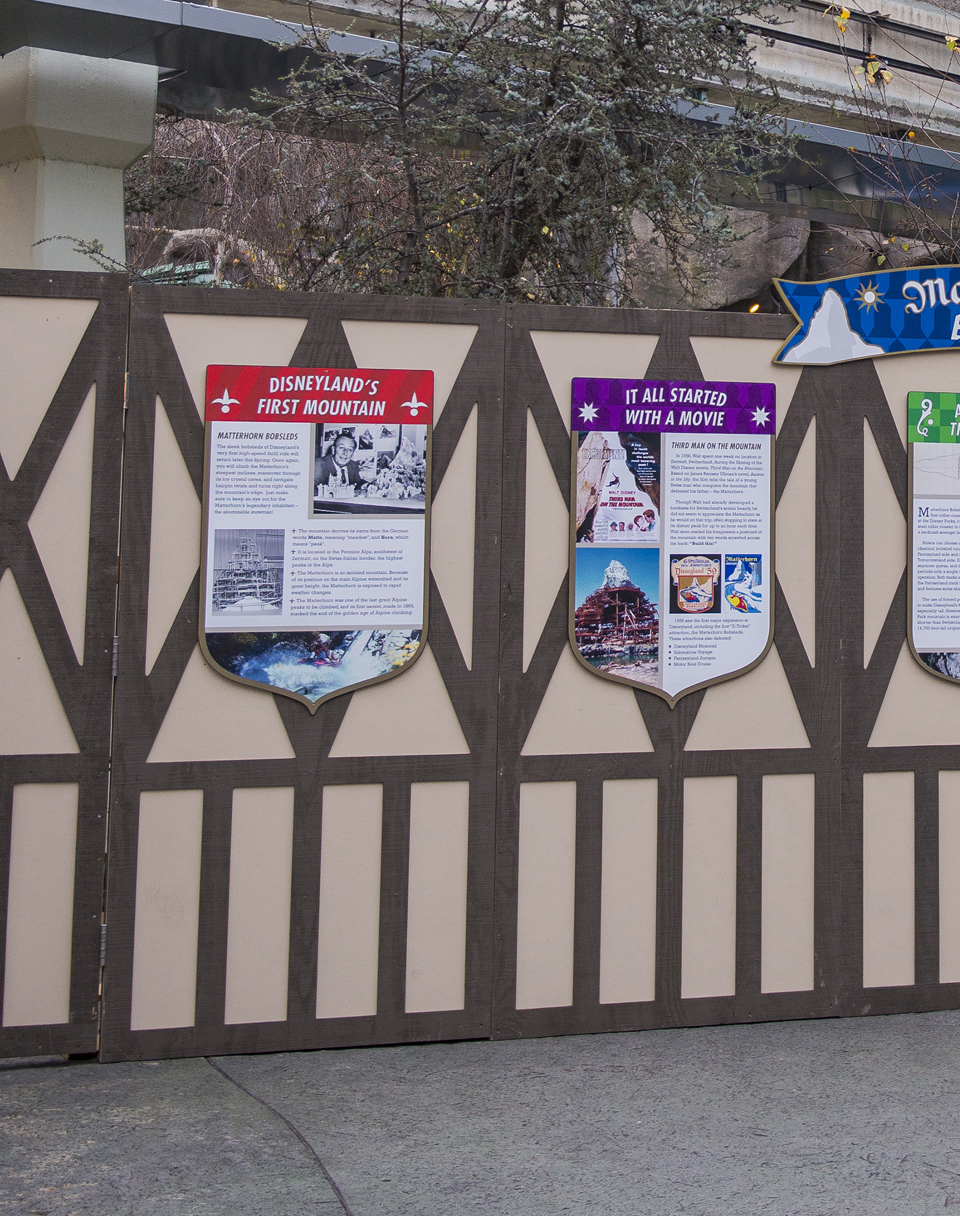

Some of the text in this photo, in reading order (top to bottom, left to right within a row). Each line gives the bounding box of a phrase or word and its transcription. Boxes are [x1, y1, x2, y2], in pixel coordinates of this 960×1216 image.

[269, 375, 379, 396] DISNEYLAND'S
[626, 388, 727, 406] IT ALL STARTED
[257, 398, 386, 416] FIRST MOUNTAIN
[626, 410, 725, 426] WITH A MOVIE
